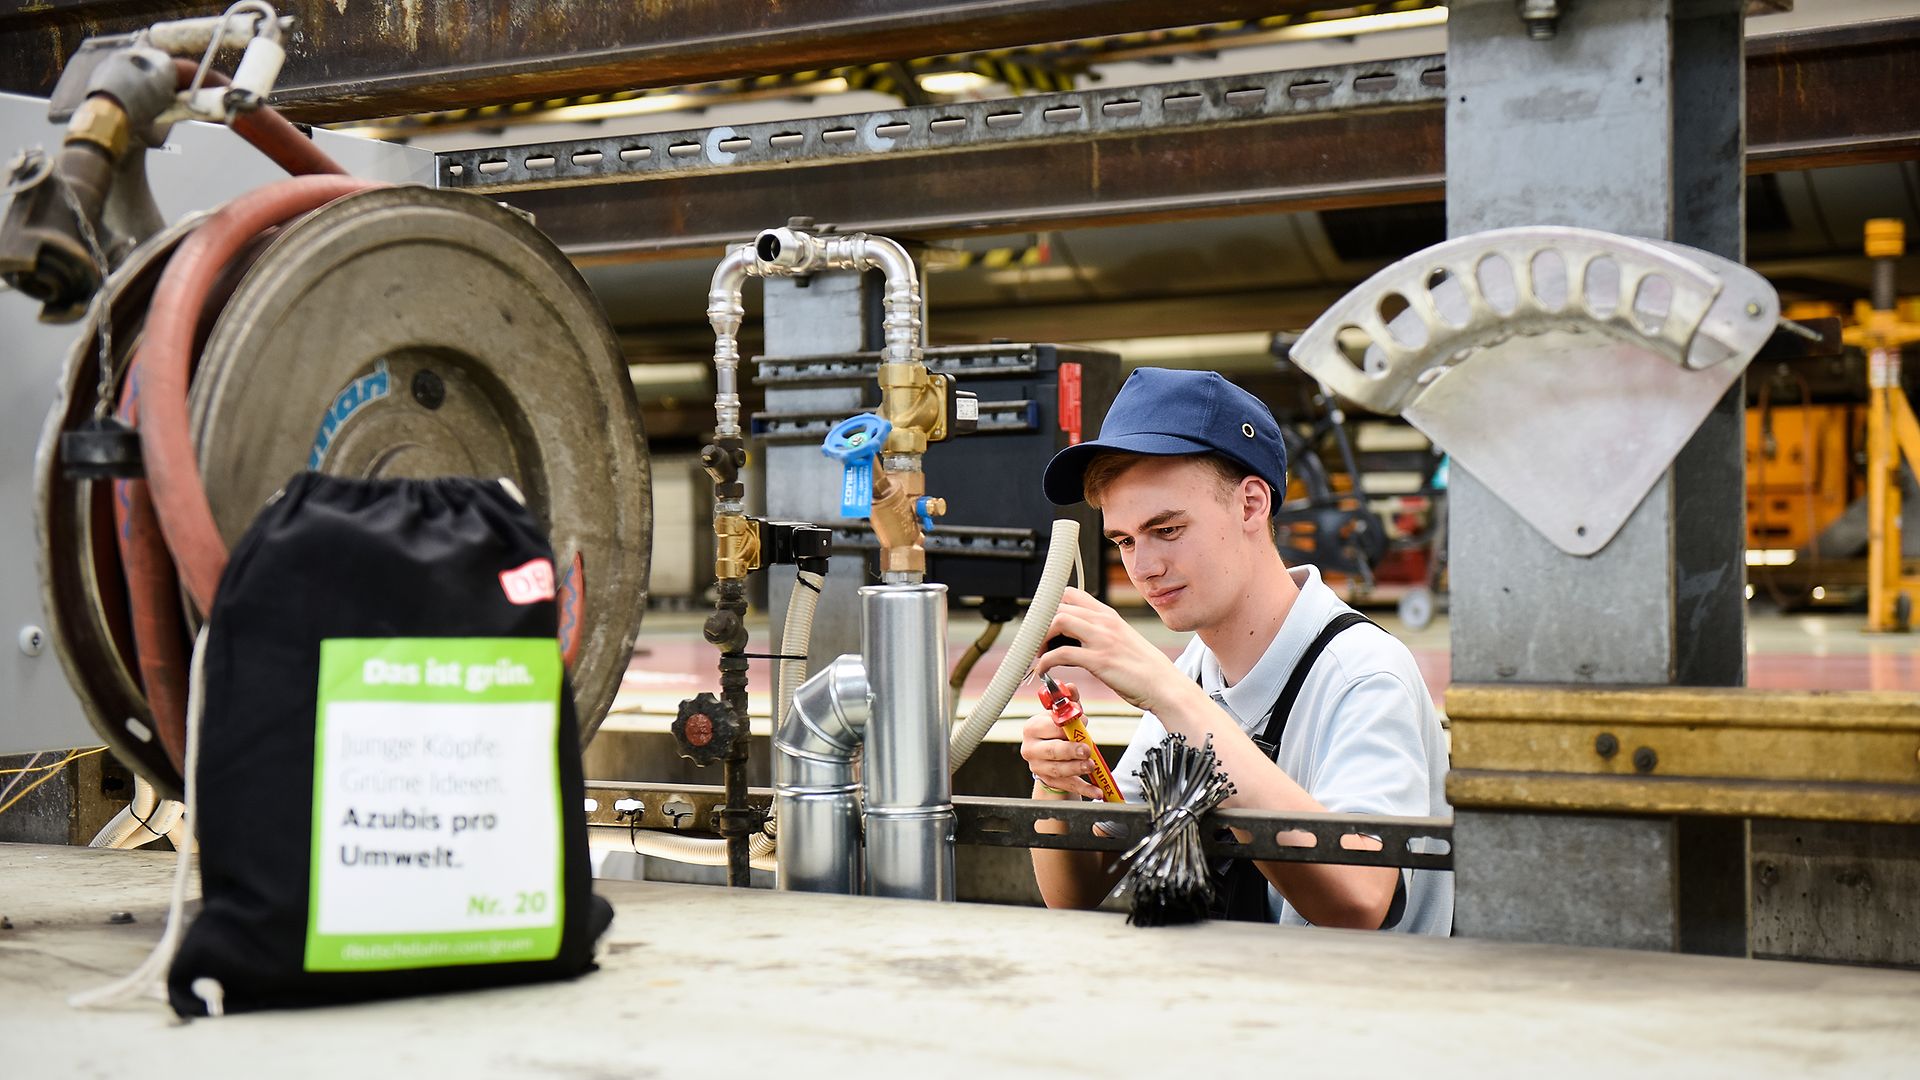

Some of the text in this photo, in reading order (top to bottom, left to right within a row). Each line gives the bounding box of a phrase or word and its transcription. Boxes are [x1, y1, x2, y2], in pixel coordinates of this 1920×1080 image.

[363, 657, 534, 693] Das ist grün.
[341, 731, 415, 762] Junge
[340, 767, 424, 794] Grüne
[342, 807, 499, 836] Azubis pro
[340, 845, 464, 869] Umwelt.
[466, 891, 547, 916] Nr. 20
